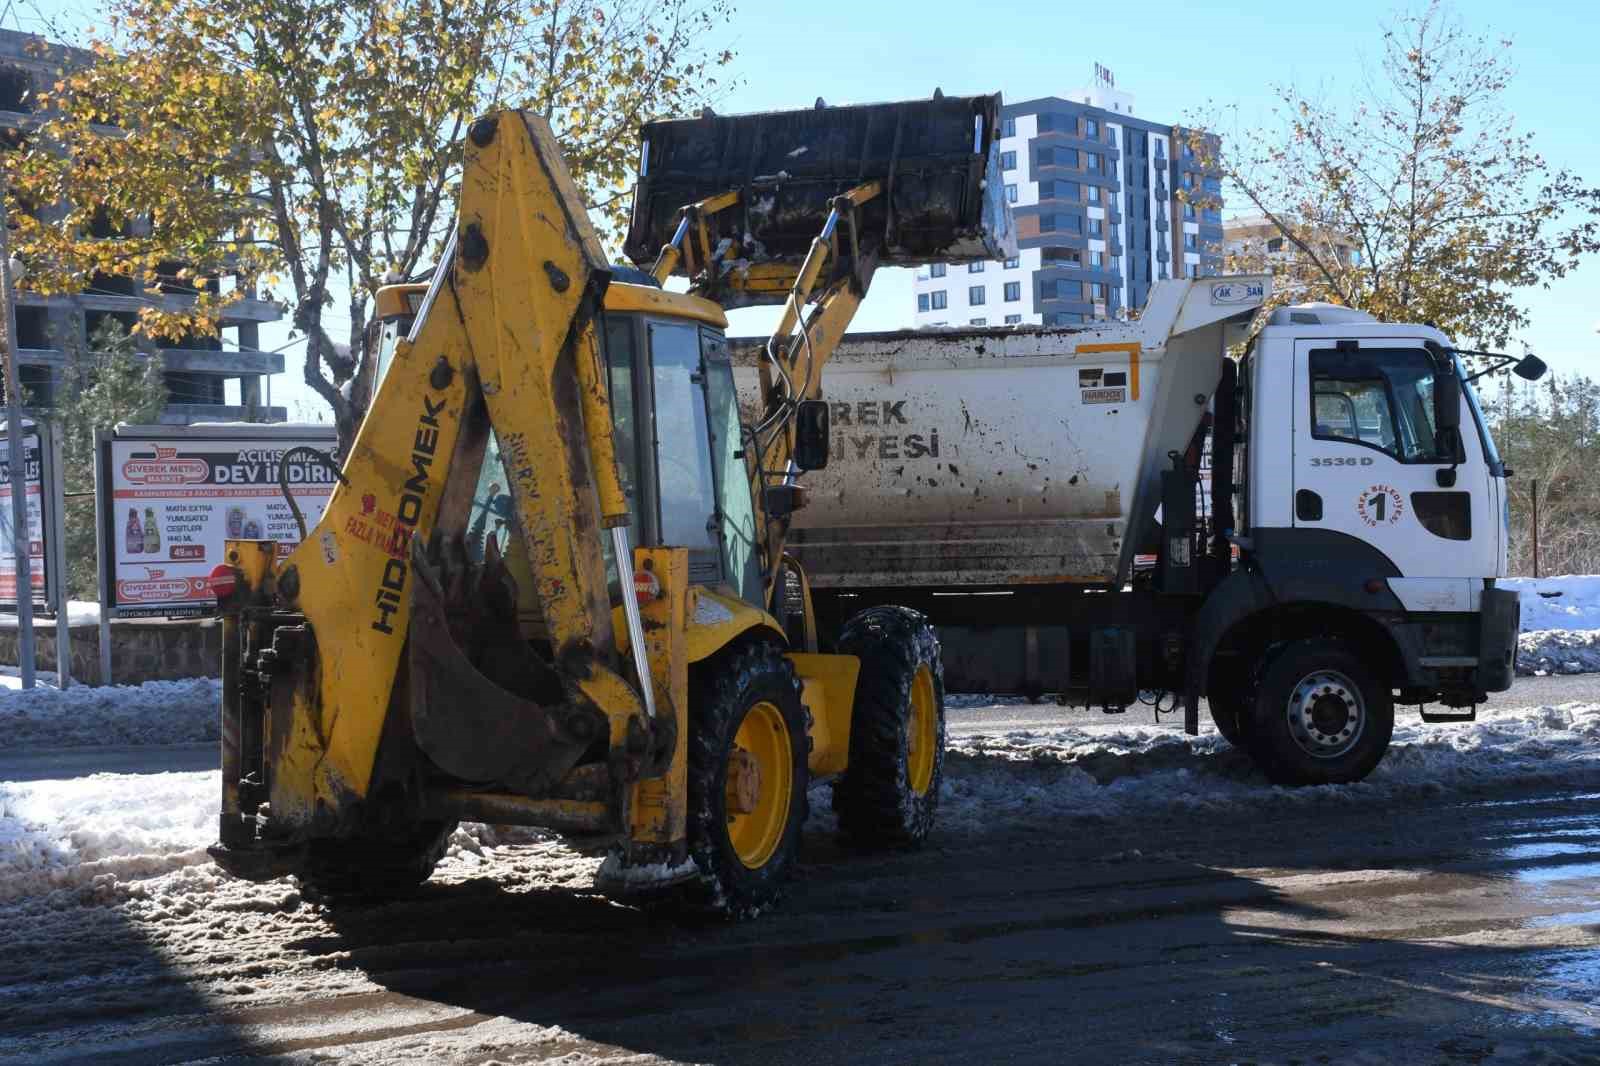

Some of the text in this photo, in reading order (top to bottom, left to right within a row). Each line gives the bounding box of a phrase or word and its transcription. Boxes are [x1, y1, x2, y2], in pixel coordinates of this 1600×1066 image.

[830, 400, 908, 425] REK
[835, 428, 939, 460] İYESİ
[214, 464, 260, 483] DEV
[1311, 457, 1374, 467] 3536 D
[1368, 493, 1386, 521] 1
